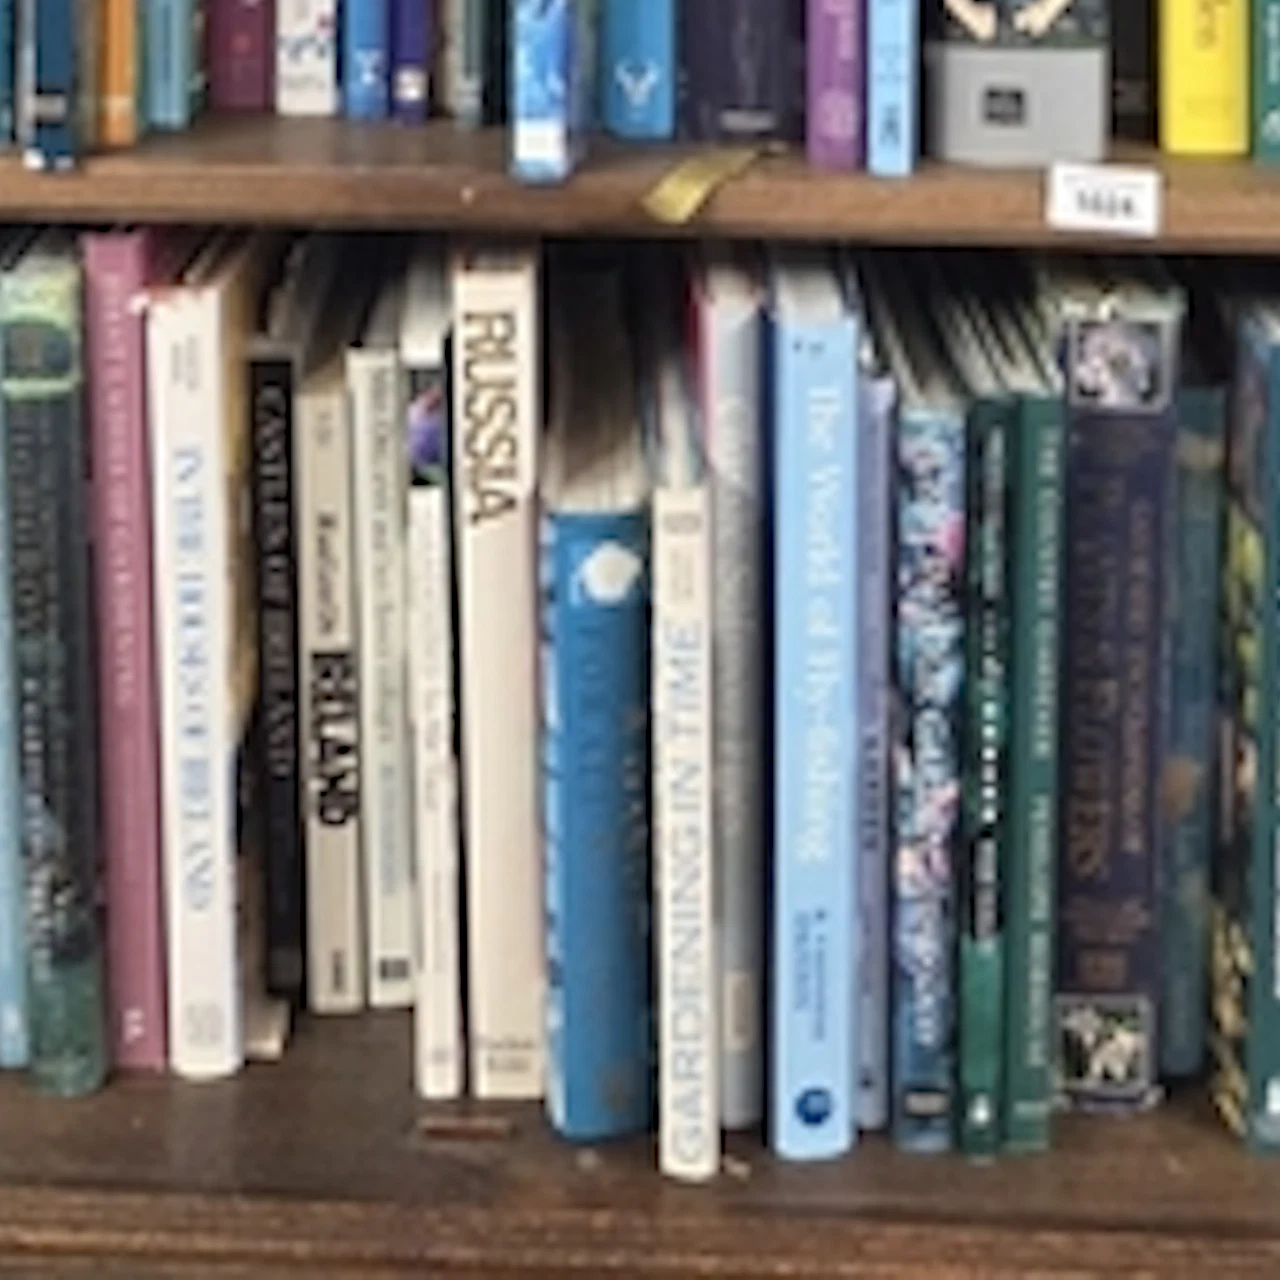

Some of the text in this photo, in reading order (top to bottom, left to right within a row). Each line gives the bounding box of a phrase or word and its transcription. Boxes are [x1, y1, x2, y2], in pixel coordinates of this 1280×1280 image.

[258, 386, 290, 552] CASTLES
[464, 311, 520, 525] RUSSIA
[808, 384, 840, 452] The
[263, 557, 292, 603] OF
[807, 466, 841, 586] World
[807, 597, 839, 638] of
[312, 649, 360, 828] IRELAND
[182, 755, 212, 912] IRELAND
[666, 621, 704, 1167] GARDENING IN TIME
